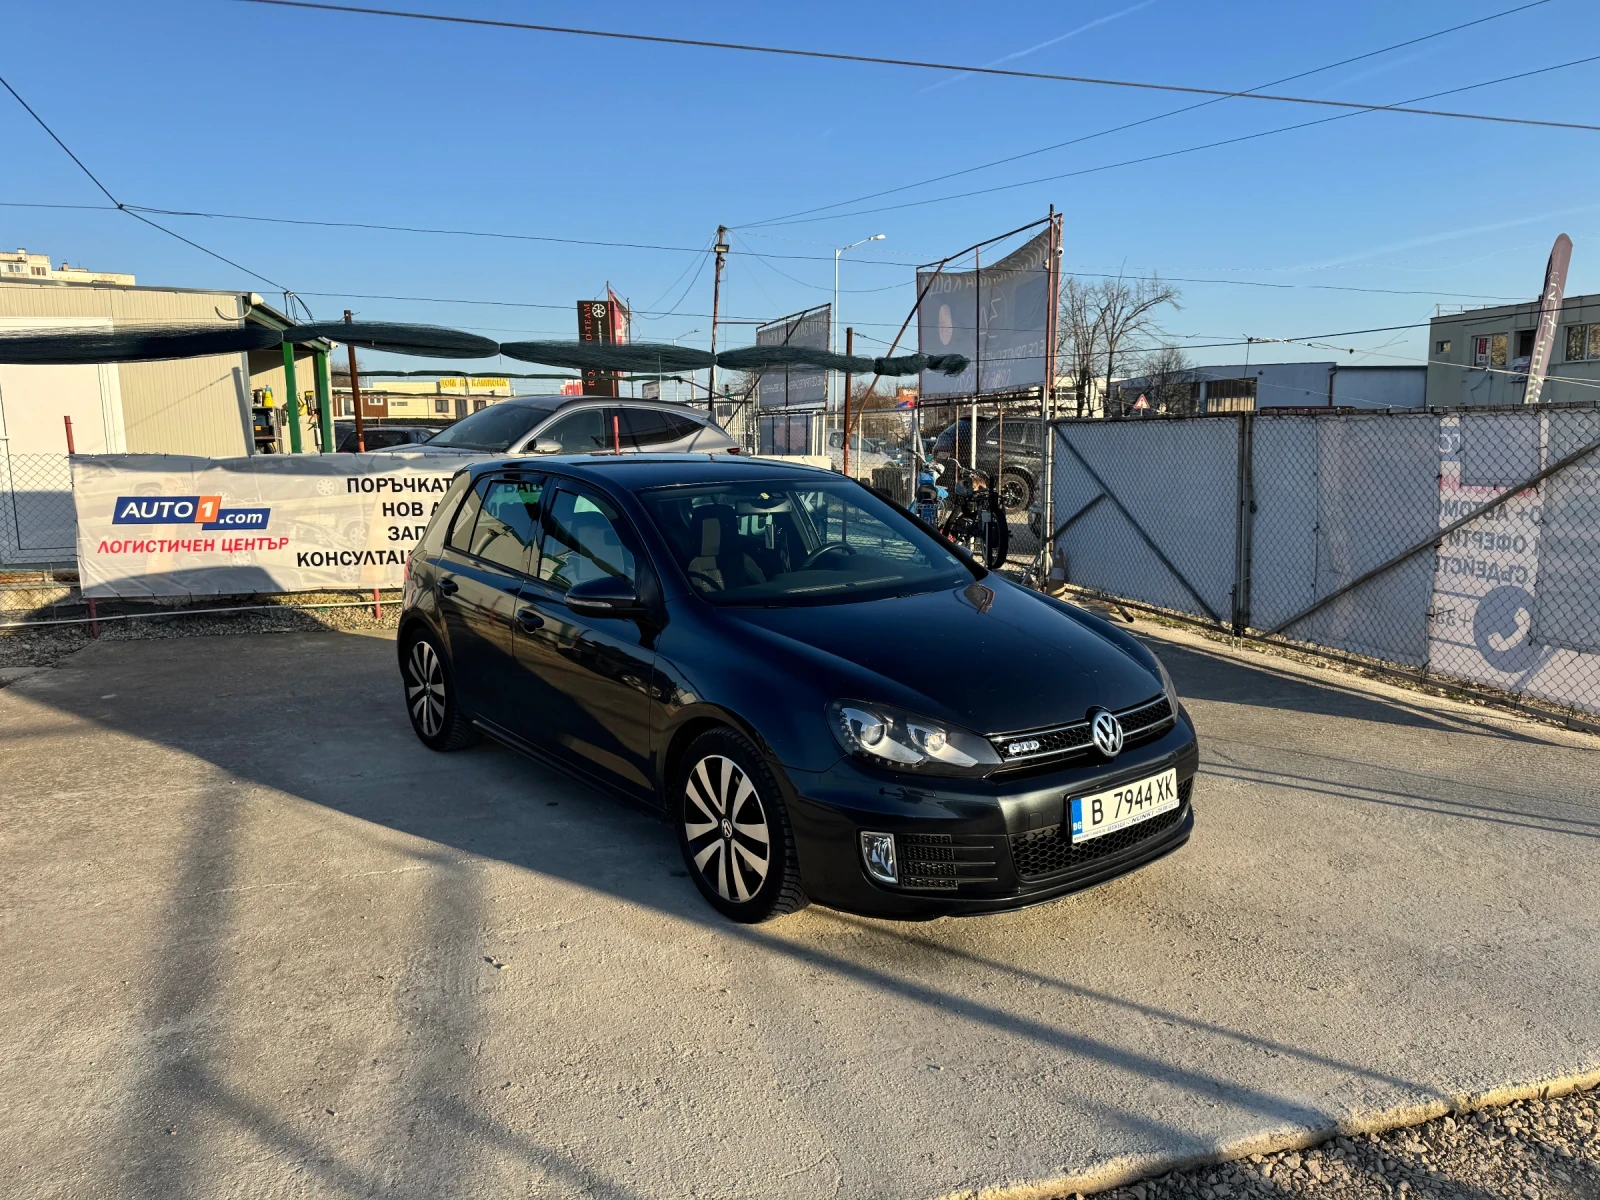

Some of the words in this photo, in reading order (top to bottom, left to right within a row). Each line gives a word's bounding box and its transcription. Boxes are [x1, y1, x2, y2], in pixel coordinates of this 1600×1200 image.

[382, 502, 423, 518] НОВ
[97, 537, 216, 555] ЛОГИСТИЧЕН
[220, 536, 290, 555] ЦЕНТЪР
[1008, 740, 1040, 754] GTD
[1091, 799, 1104, 826] B
[1113, 785, 1153, 820] 7944
[1156, 772, 1174, 804] XK
[1072, 821, 1082, 831] BG
